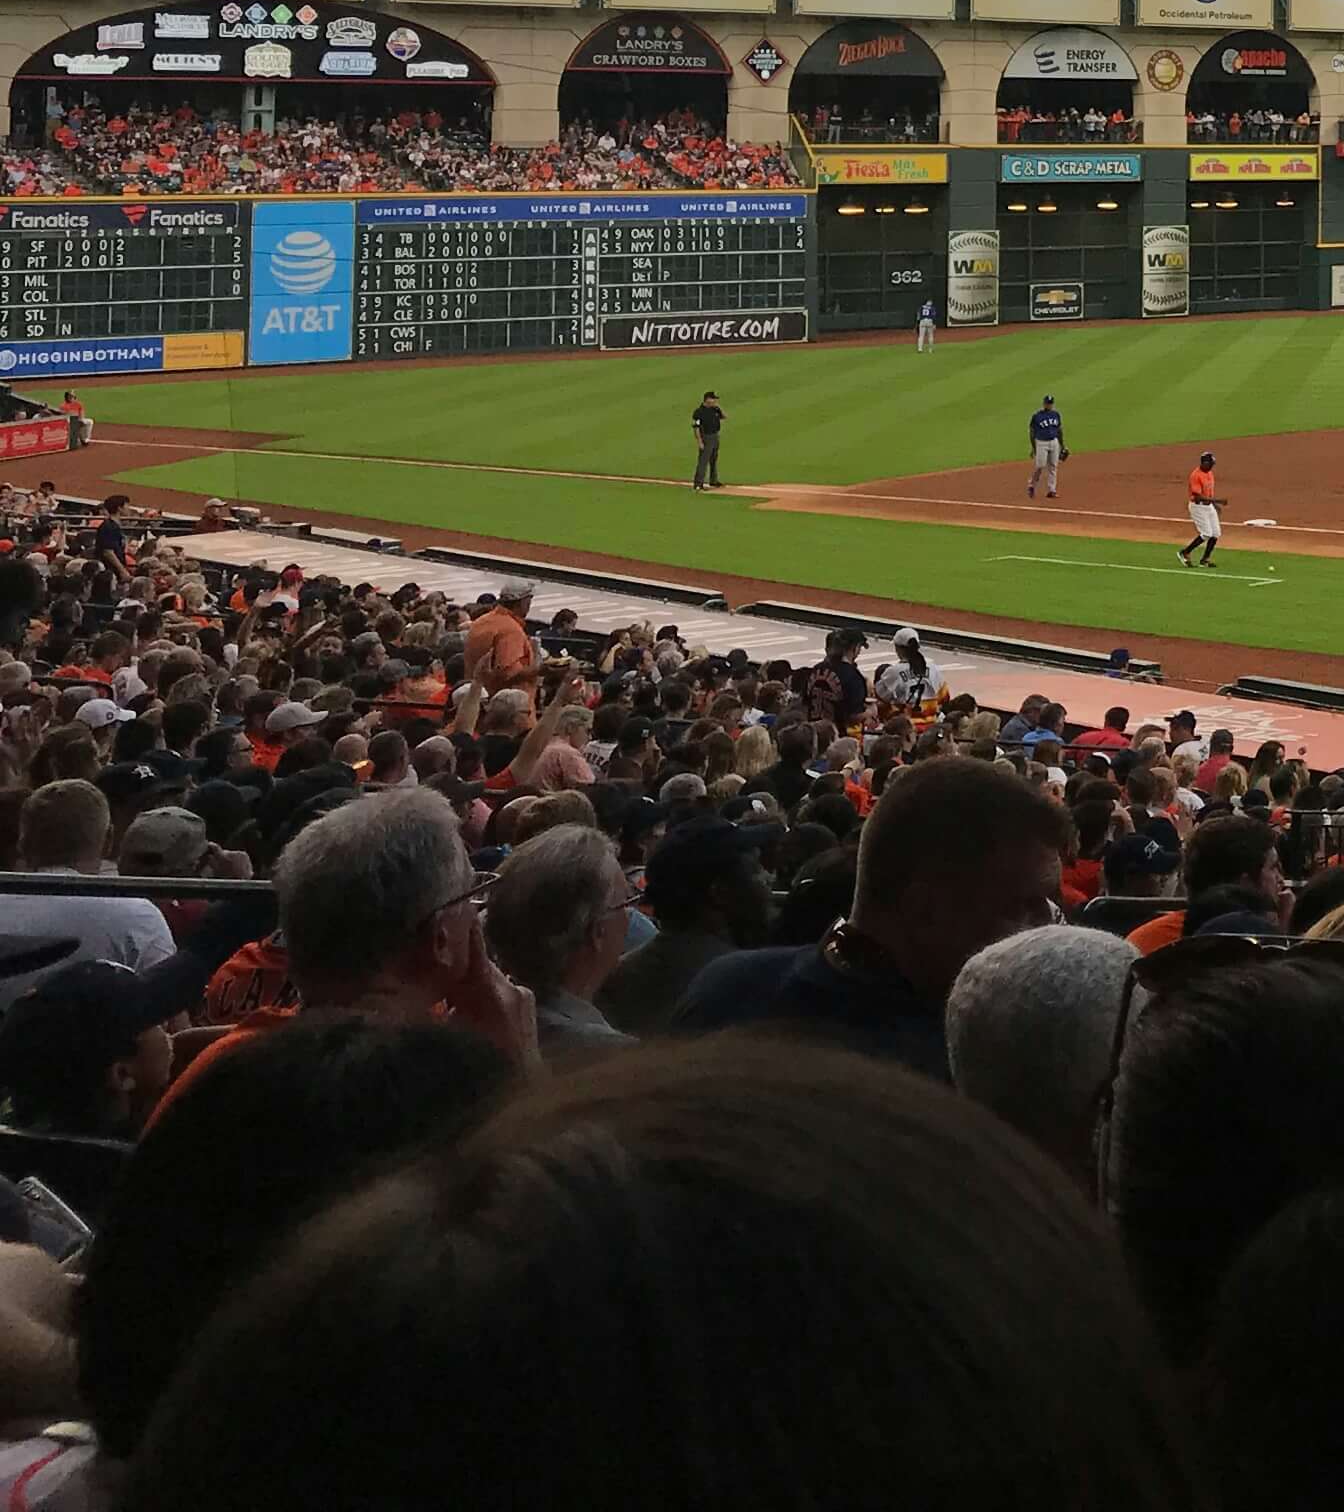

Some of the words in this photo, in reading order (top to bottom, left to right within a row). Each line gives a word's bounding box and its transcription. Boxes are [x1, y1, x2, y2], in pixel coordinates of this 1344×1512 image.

[1159, 9, 1208, 20] Occidental
[1208, 10, 1253, 21] Petroleum
[219, 23, 319, 40] LANDRY'S
[616, 39, 684, 51] LANDRY'S
[592, 54, 665, 67] CRAWFORD
[668, 55, 707, 68] BOXES
[1066, 49, 1107, 61] ENERGY
[1240, 49, 1287, 66] apache
[1066, 61, 1118, 73] TRANSFER
[843, 159, 890, 178] Fiesta
[1054, 162, 1093, 176] SCRAP
[1096, 161, 1133, 175] METAL
[374, 207, 422, 217] UNITED
[438, 205, 497, 215] AIRLINES
[531, 204, 577, 214] UNITED
[593, 204, 650, 213] AIRLINES
[681, 203, 724, 212] UNITED
[739, 202, 792, 211] AIRLINES
[11, 210, 90, 229] Fanatics
[150, 209, 224, 226] Fanatics
[630, 228, 655, 239] OAK
[30, 240, 45, 253] SF
[394, 248, 416, 258] BAL
[27, 256, 48, 268] PIT
[632, 258, 653, 269] SEA
[1147, 252, 1185, 268] WM
[394, 264, 416, 275] BOS
[952, 259, 993, 274] WM
[24, 275, 49, 287] MIL
[891, 270, 923, 285] 362
[23, 291, 49, 303] COL
[631, 288, 653, 299] MIN
[631, 300, 653, 312] LAA
[24, 309, 47, 322] STL
[262, 304, 341, 335] AT&T
[393, 310, 413, 321] CLE
[26, 324, 44, 337] SD
[390, 327, 416, 338] CWS
[631, 316, 780, 344] NITTOTIRE.COM
[393, 342, 413, 352] CHI
[18, 348, 155, 366] HIGGINBOTHAM
